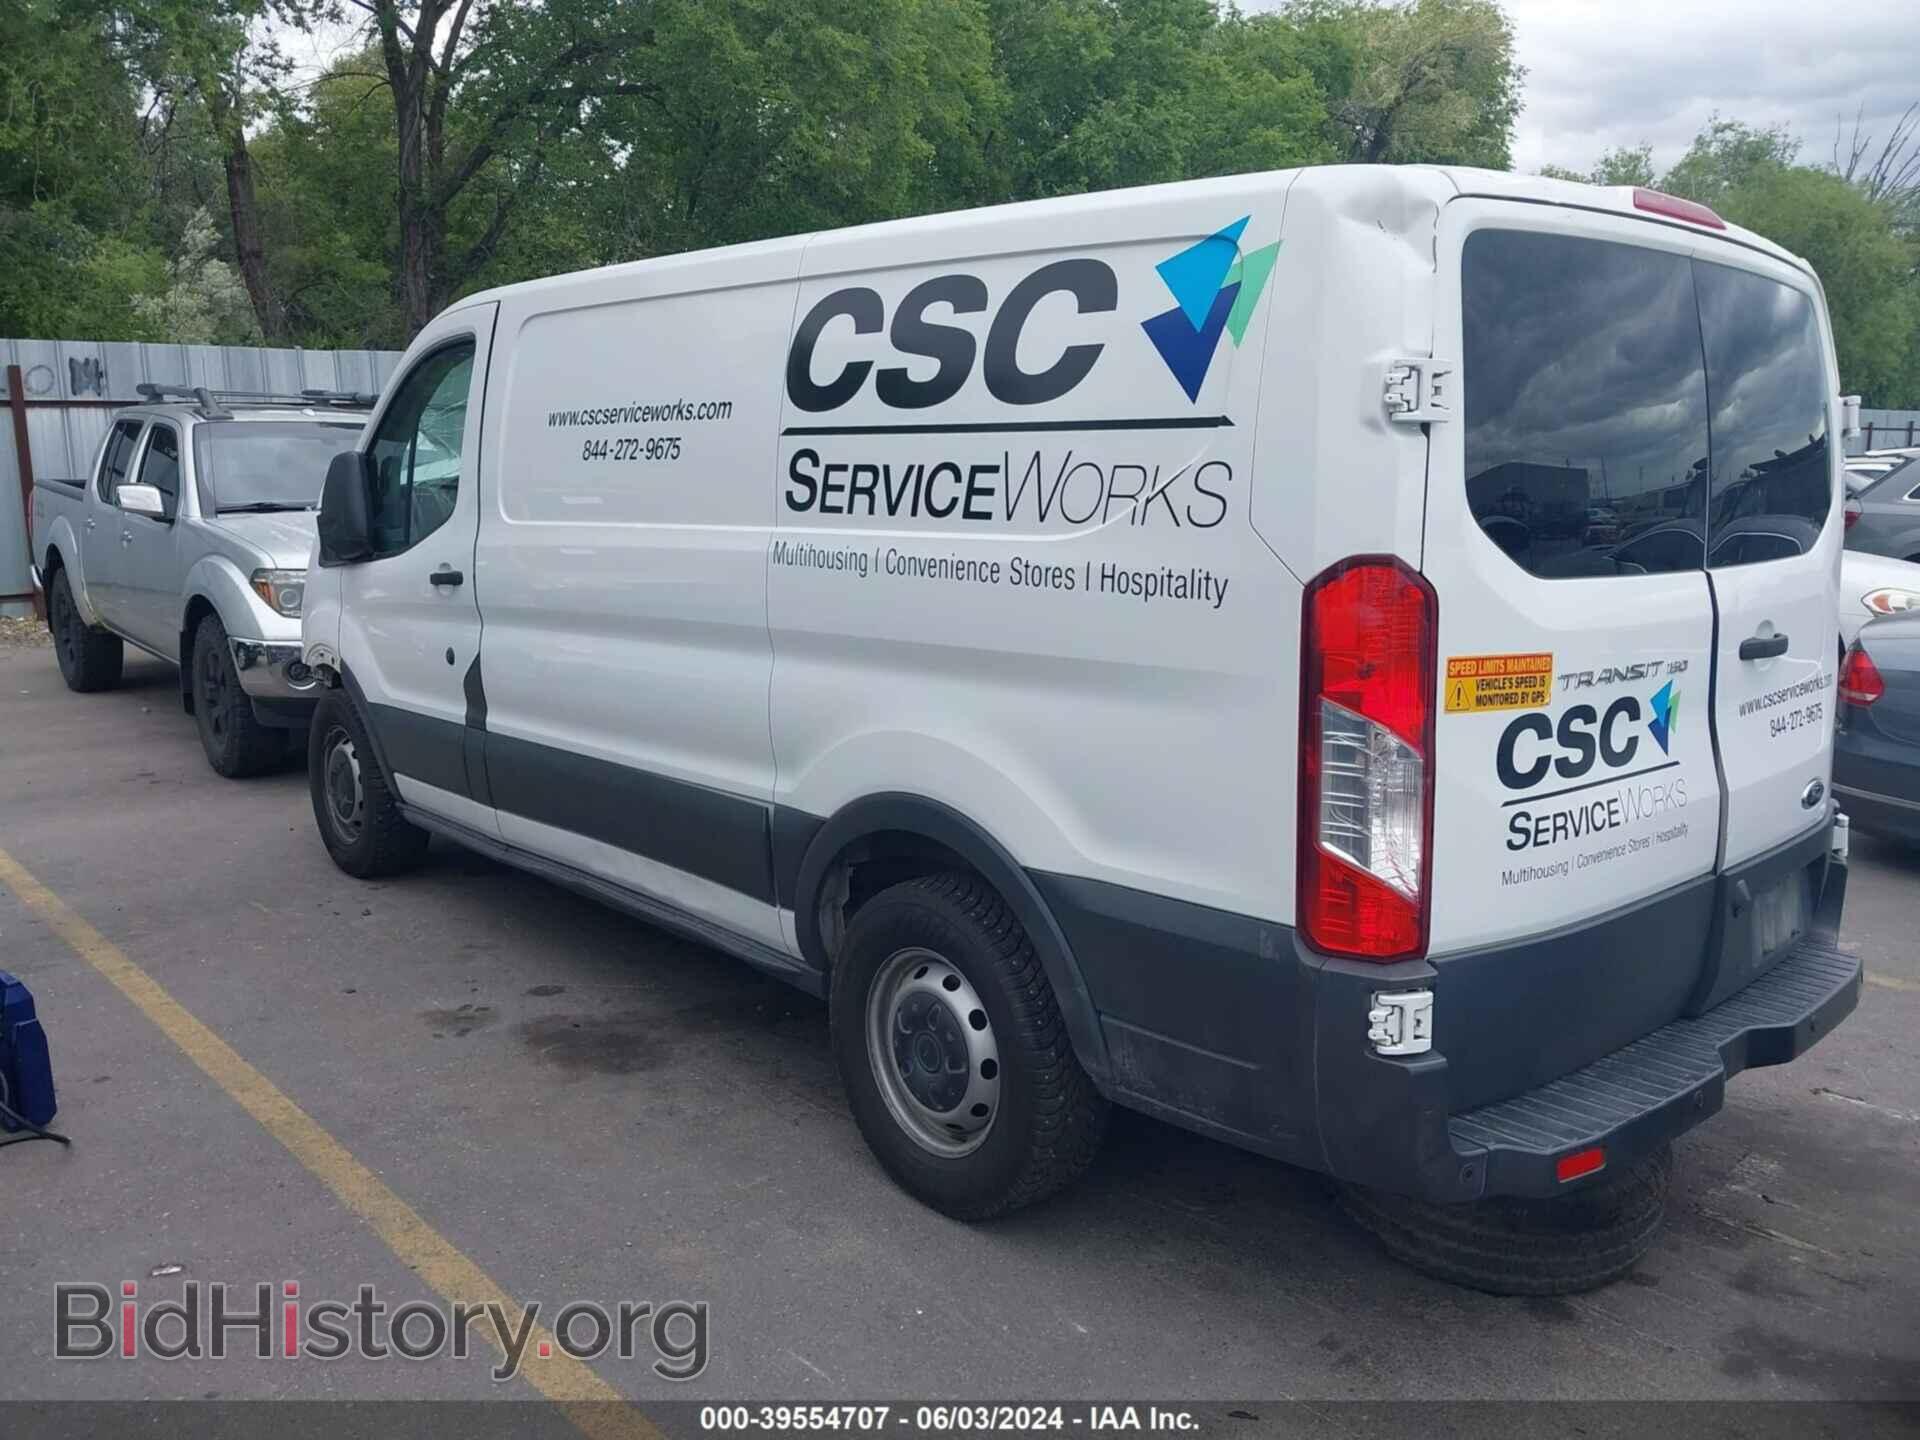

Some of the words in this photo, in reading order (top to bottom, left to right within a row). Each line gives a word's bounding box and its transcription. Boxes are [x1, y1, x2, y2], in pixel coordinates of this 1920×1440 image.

[786, 258, 1118, 412] CSC
[548, 398, 732, 427] www.cscserviceworks.com
[582, 437, 681, 461] 844-272-9675
[773, 541, 868, 578] Multihousing
[885, 549, 1000, 585] Convenience
[1010, 557, 1076, 591] Stores
[1100, 563, 1228, 609] Hospitality
[1449, 660, 1477, 675] SPEED
[1478, 658, 1505, 674] LIMITS
[1506, 655, 1552, 672] MAINTAINED
[1558, 660, 1664, 691] TRANSIT
[1475, 677, 1513, 691] VEHICLE'S
[1514, 675, 1537, 689] SPEED
[1538, 674, 1545, 688] IS
[1475, 693, 1519, 707] MONITORED
[1520, 691, 1530, 704] BY
[1531, 689, 1545, 703] GPS
[1496, 696, 1641, 790] CSC
[1501, 860, 1569, 887] Multihousing
[1576, 845, 1626, 869] Convenience
[1628, 836, 1650, 853] Stores
